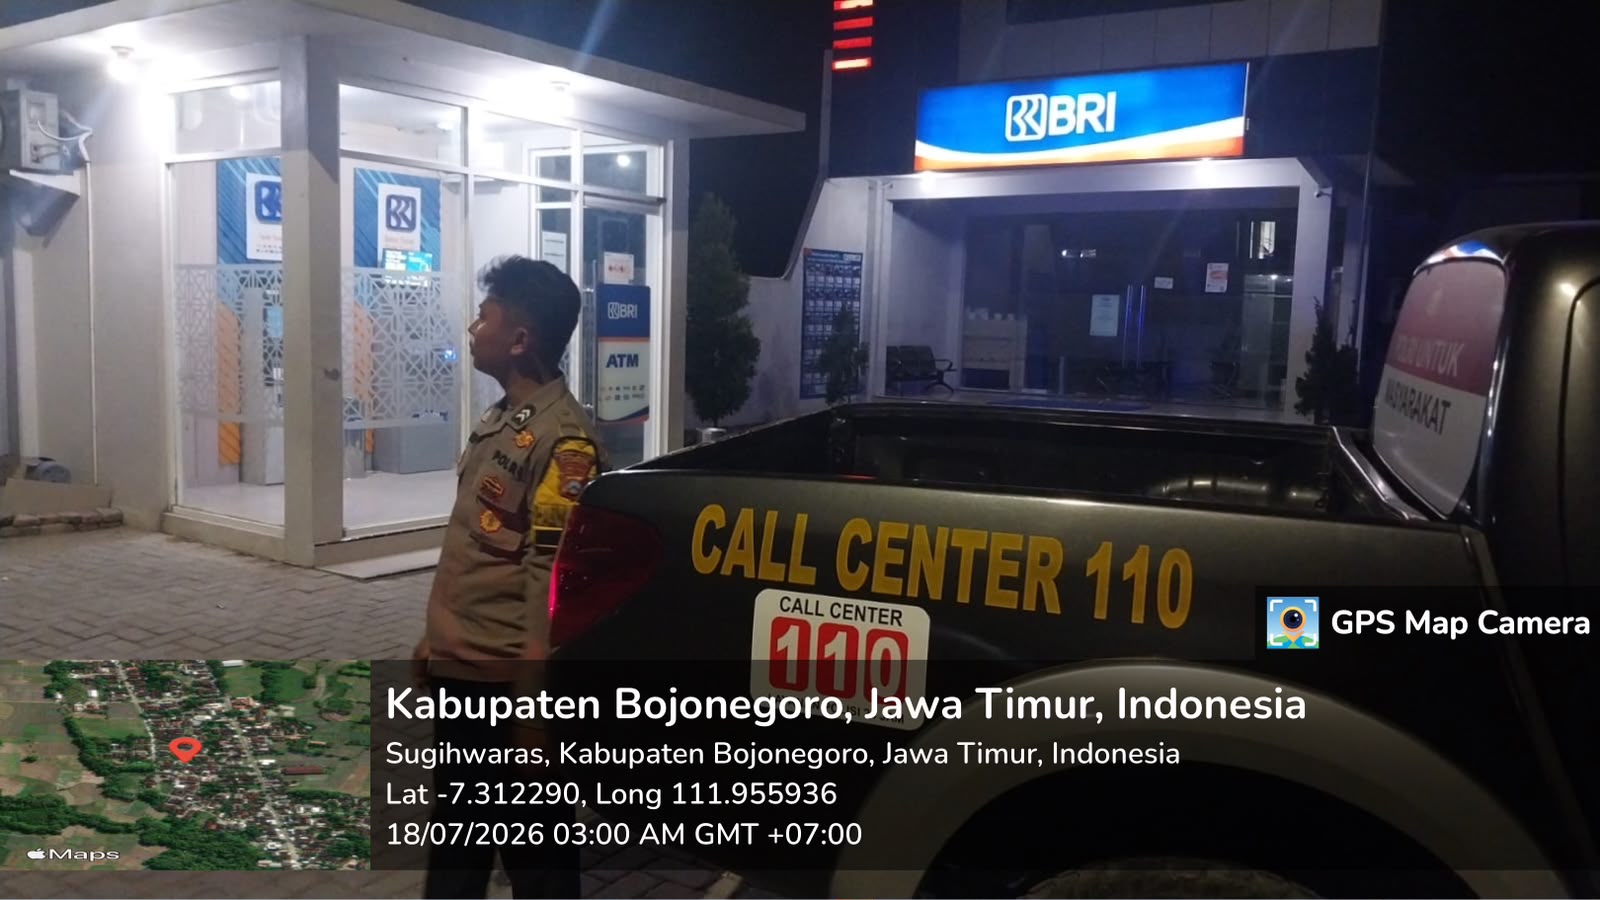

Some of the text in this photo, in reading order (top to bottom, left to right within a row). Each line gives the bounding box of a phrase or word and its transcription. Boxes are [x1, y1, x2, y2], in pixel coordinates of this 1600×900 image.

[1048, 91, 1117, 136] BRI
[605, 353, 639, 369] ATM
[691, 503, 1193, 629] CALL CENTER 110
[779, 596, 903, 627] CALL CENTER
[776, 624, 902, 701] 110
